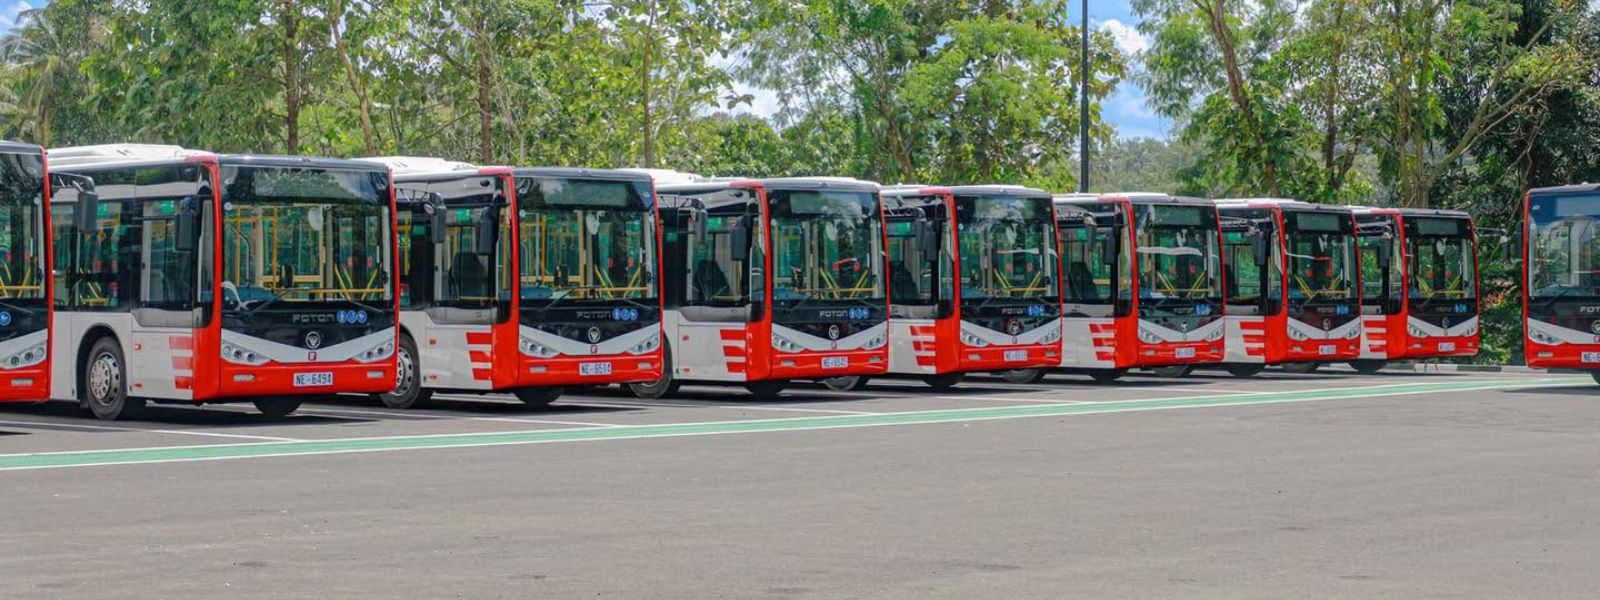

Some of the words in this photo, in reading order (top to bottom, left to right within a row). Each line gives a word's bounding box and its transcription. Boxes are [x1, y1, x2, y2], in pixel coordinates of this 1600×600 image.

[293, 314, 335, 323] FOTON
[577, 311, 612, 319] FOTON
[819, 310, 848, 319] FOTON
[296, 373, 332, 385] NE-6494
